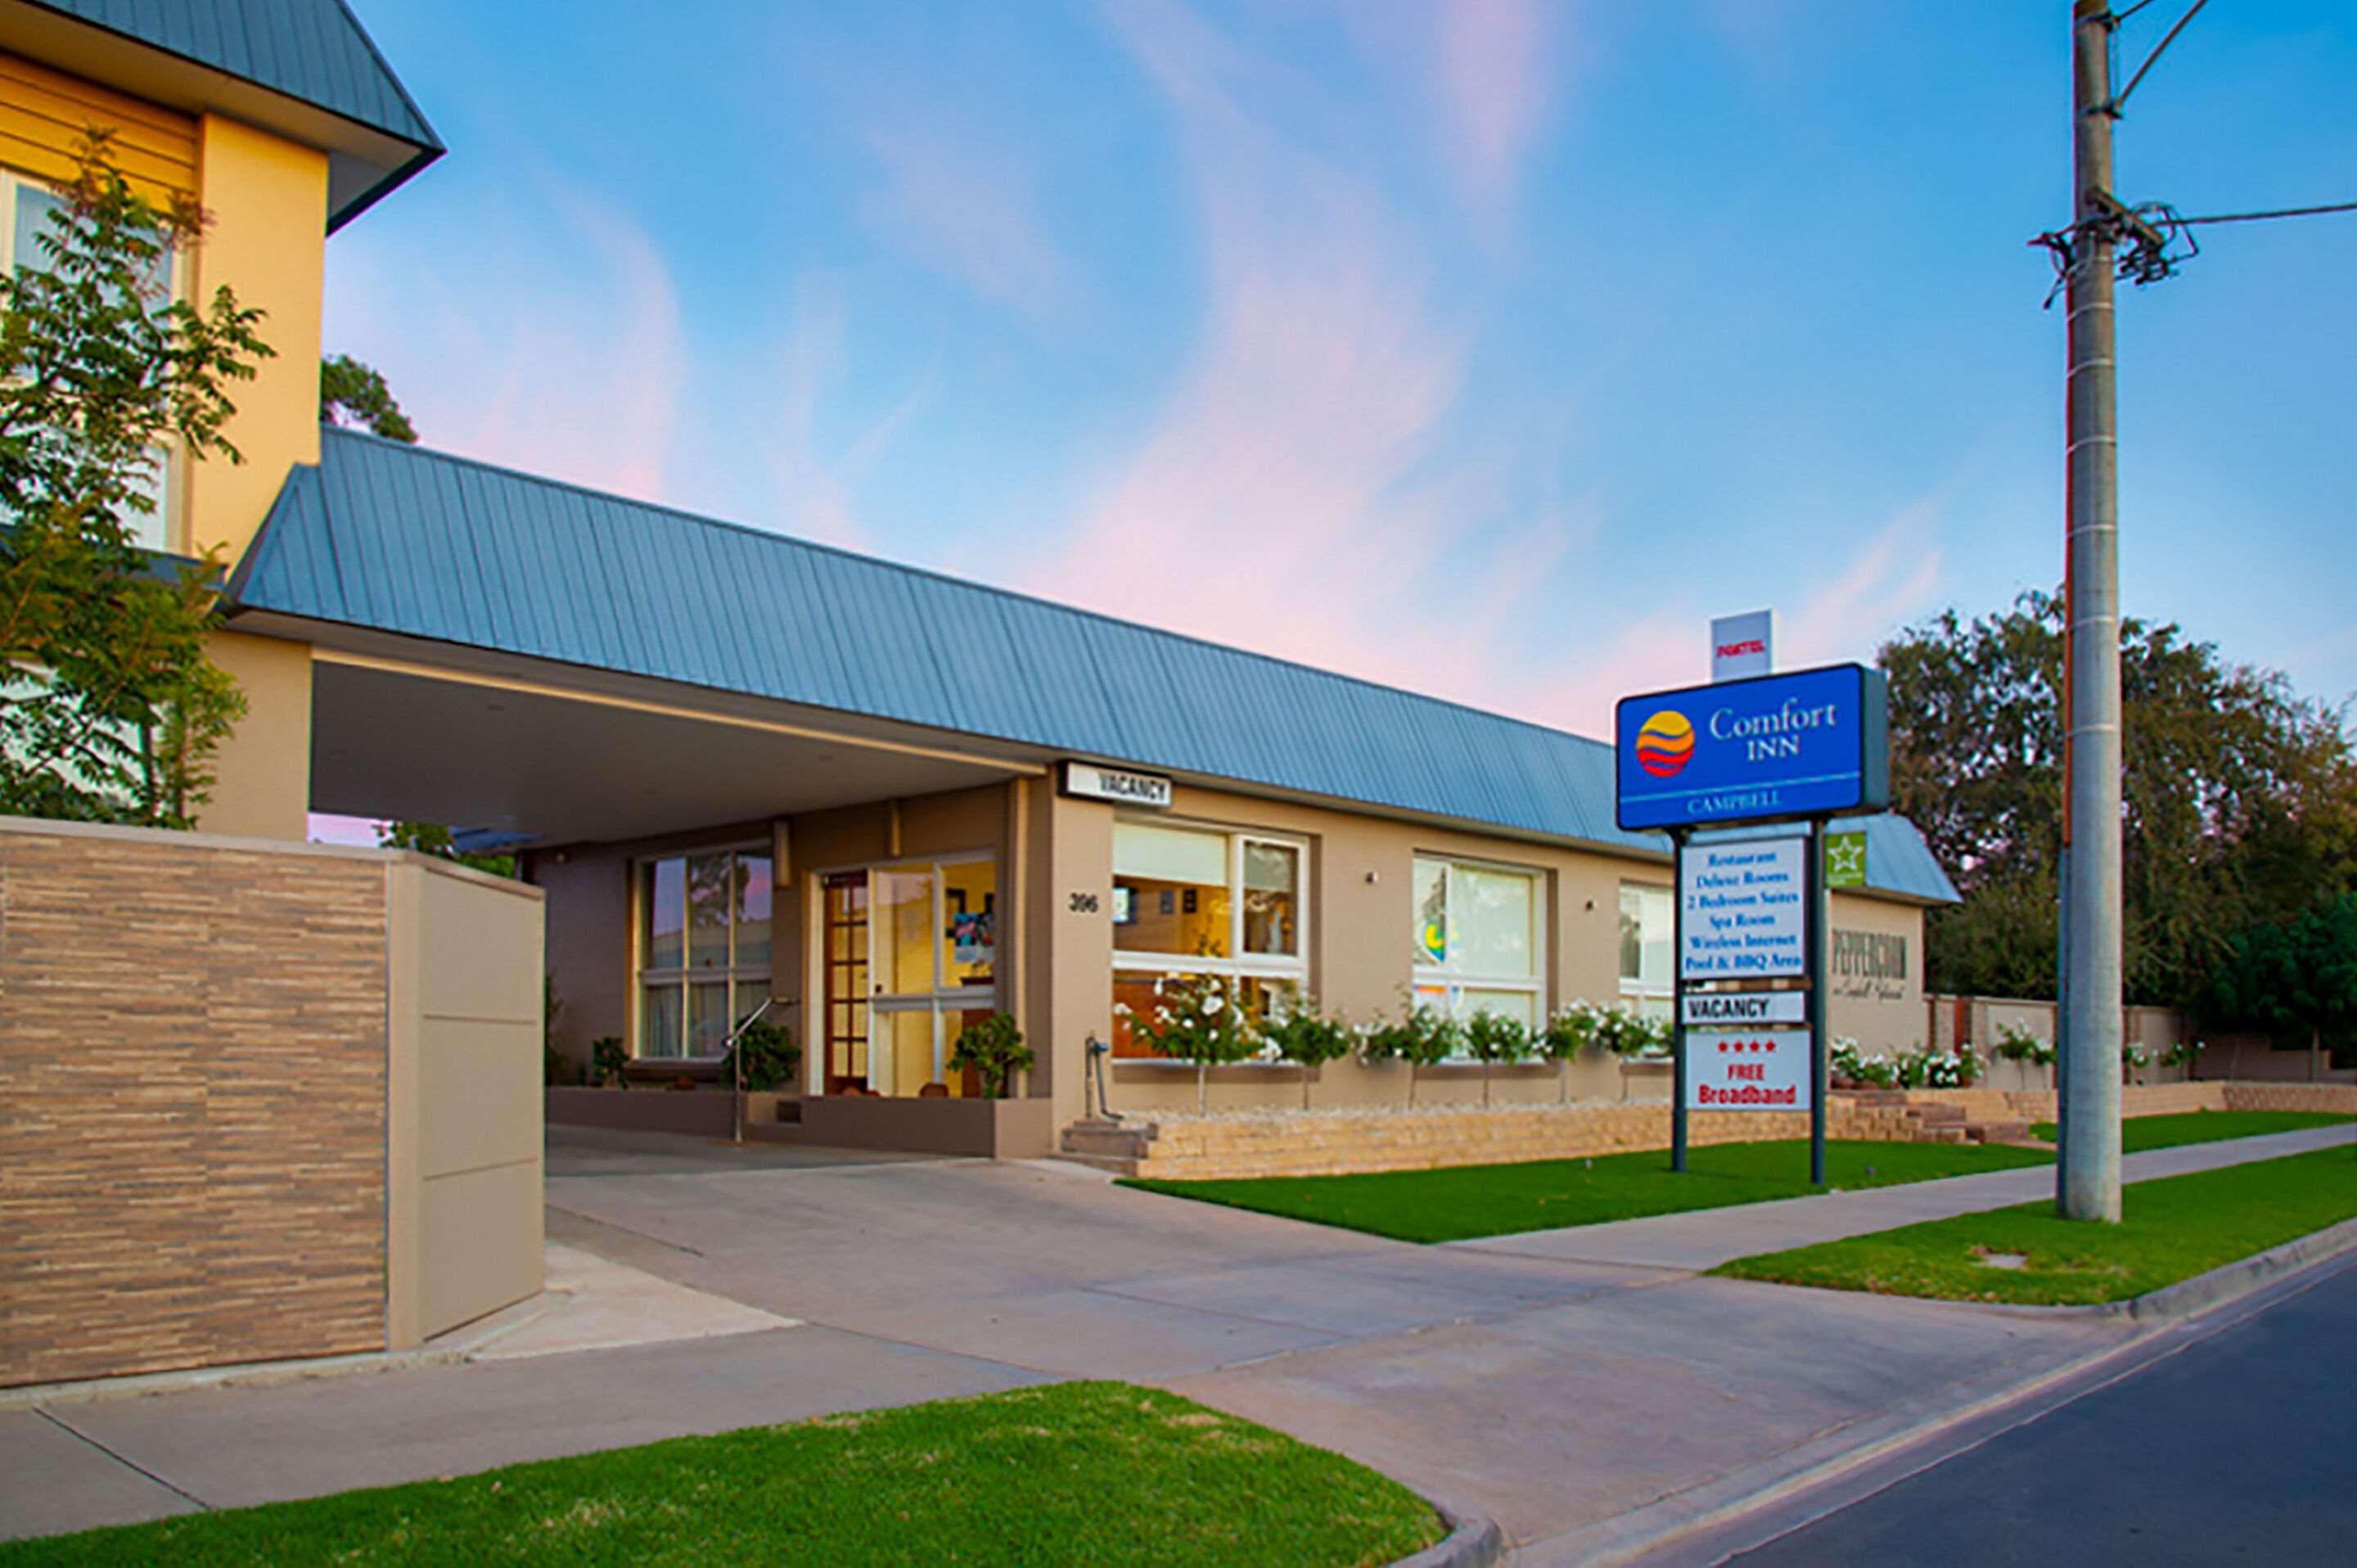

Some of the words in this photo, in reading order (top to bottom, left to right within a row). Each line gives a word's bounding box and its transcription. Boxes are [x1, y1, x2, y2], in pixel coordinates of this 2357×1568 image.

[1710, 697, 1837, 741] Comfort
[1746, 734, 1800, 761] INN
[1097, 772, 1165, 800] VACANCY
[1688, 791, 1781, 815] CAMPBELL
[1708, 852, 1777, 866] Restaurant
[1743, 871, 1789, 884] Rooms
[1699, 894, 1757, 908] Bedroom
[1736, 913, 1776, 926] Room
[1745, 934, 1796, 947] Internet
[1685, 955, 1713, 971] Pool
[1734, 953, 1768, 971] BBQ
[1772, 953, 1802, 967] Area
[1688, 998, 1770, 1018] VACANCY
[1727, 1064, 1765, 1081] FREE
[1698, 1084, 1796, 1104] Broadband
